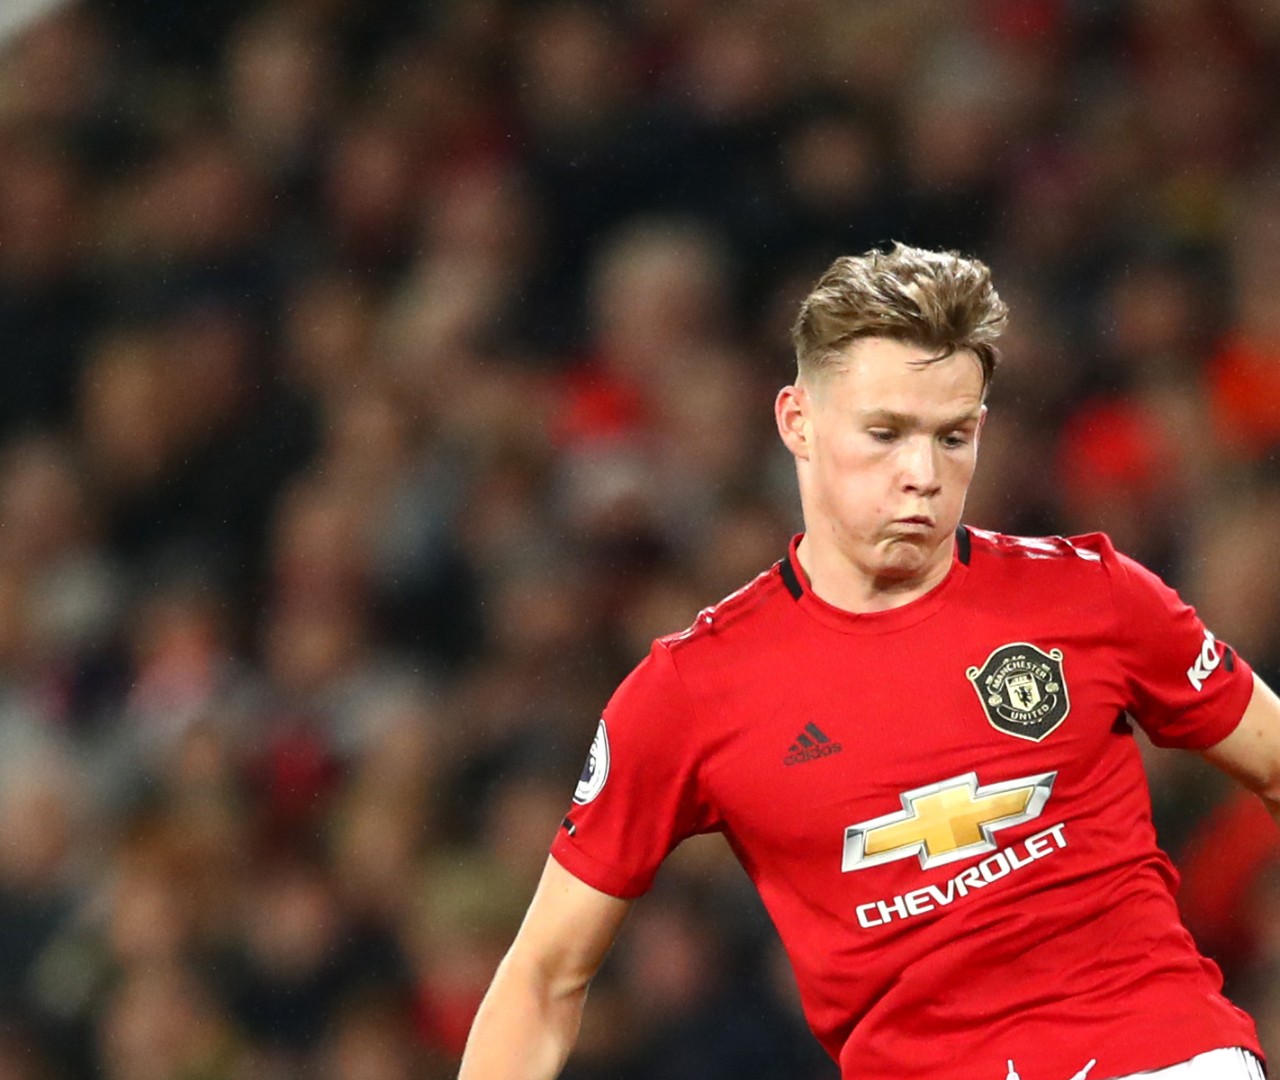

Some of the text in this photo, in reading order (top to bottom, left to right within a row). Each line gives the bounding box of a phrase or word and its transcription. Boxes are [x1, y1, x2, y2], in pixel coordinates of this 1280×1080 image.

[991, 660, 1048, 690] MANCHESTER
[1009, 703, 1050, 721] UNITED
[854, 821, 1069, 930] CHEVROLET
